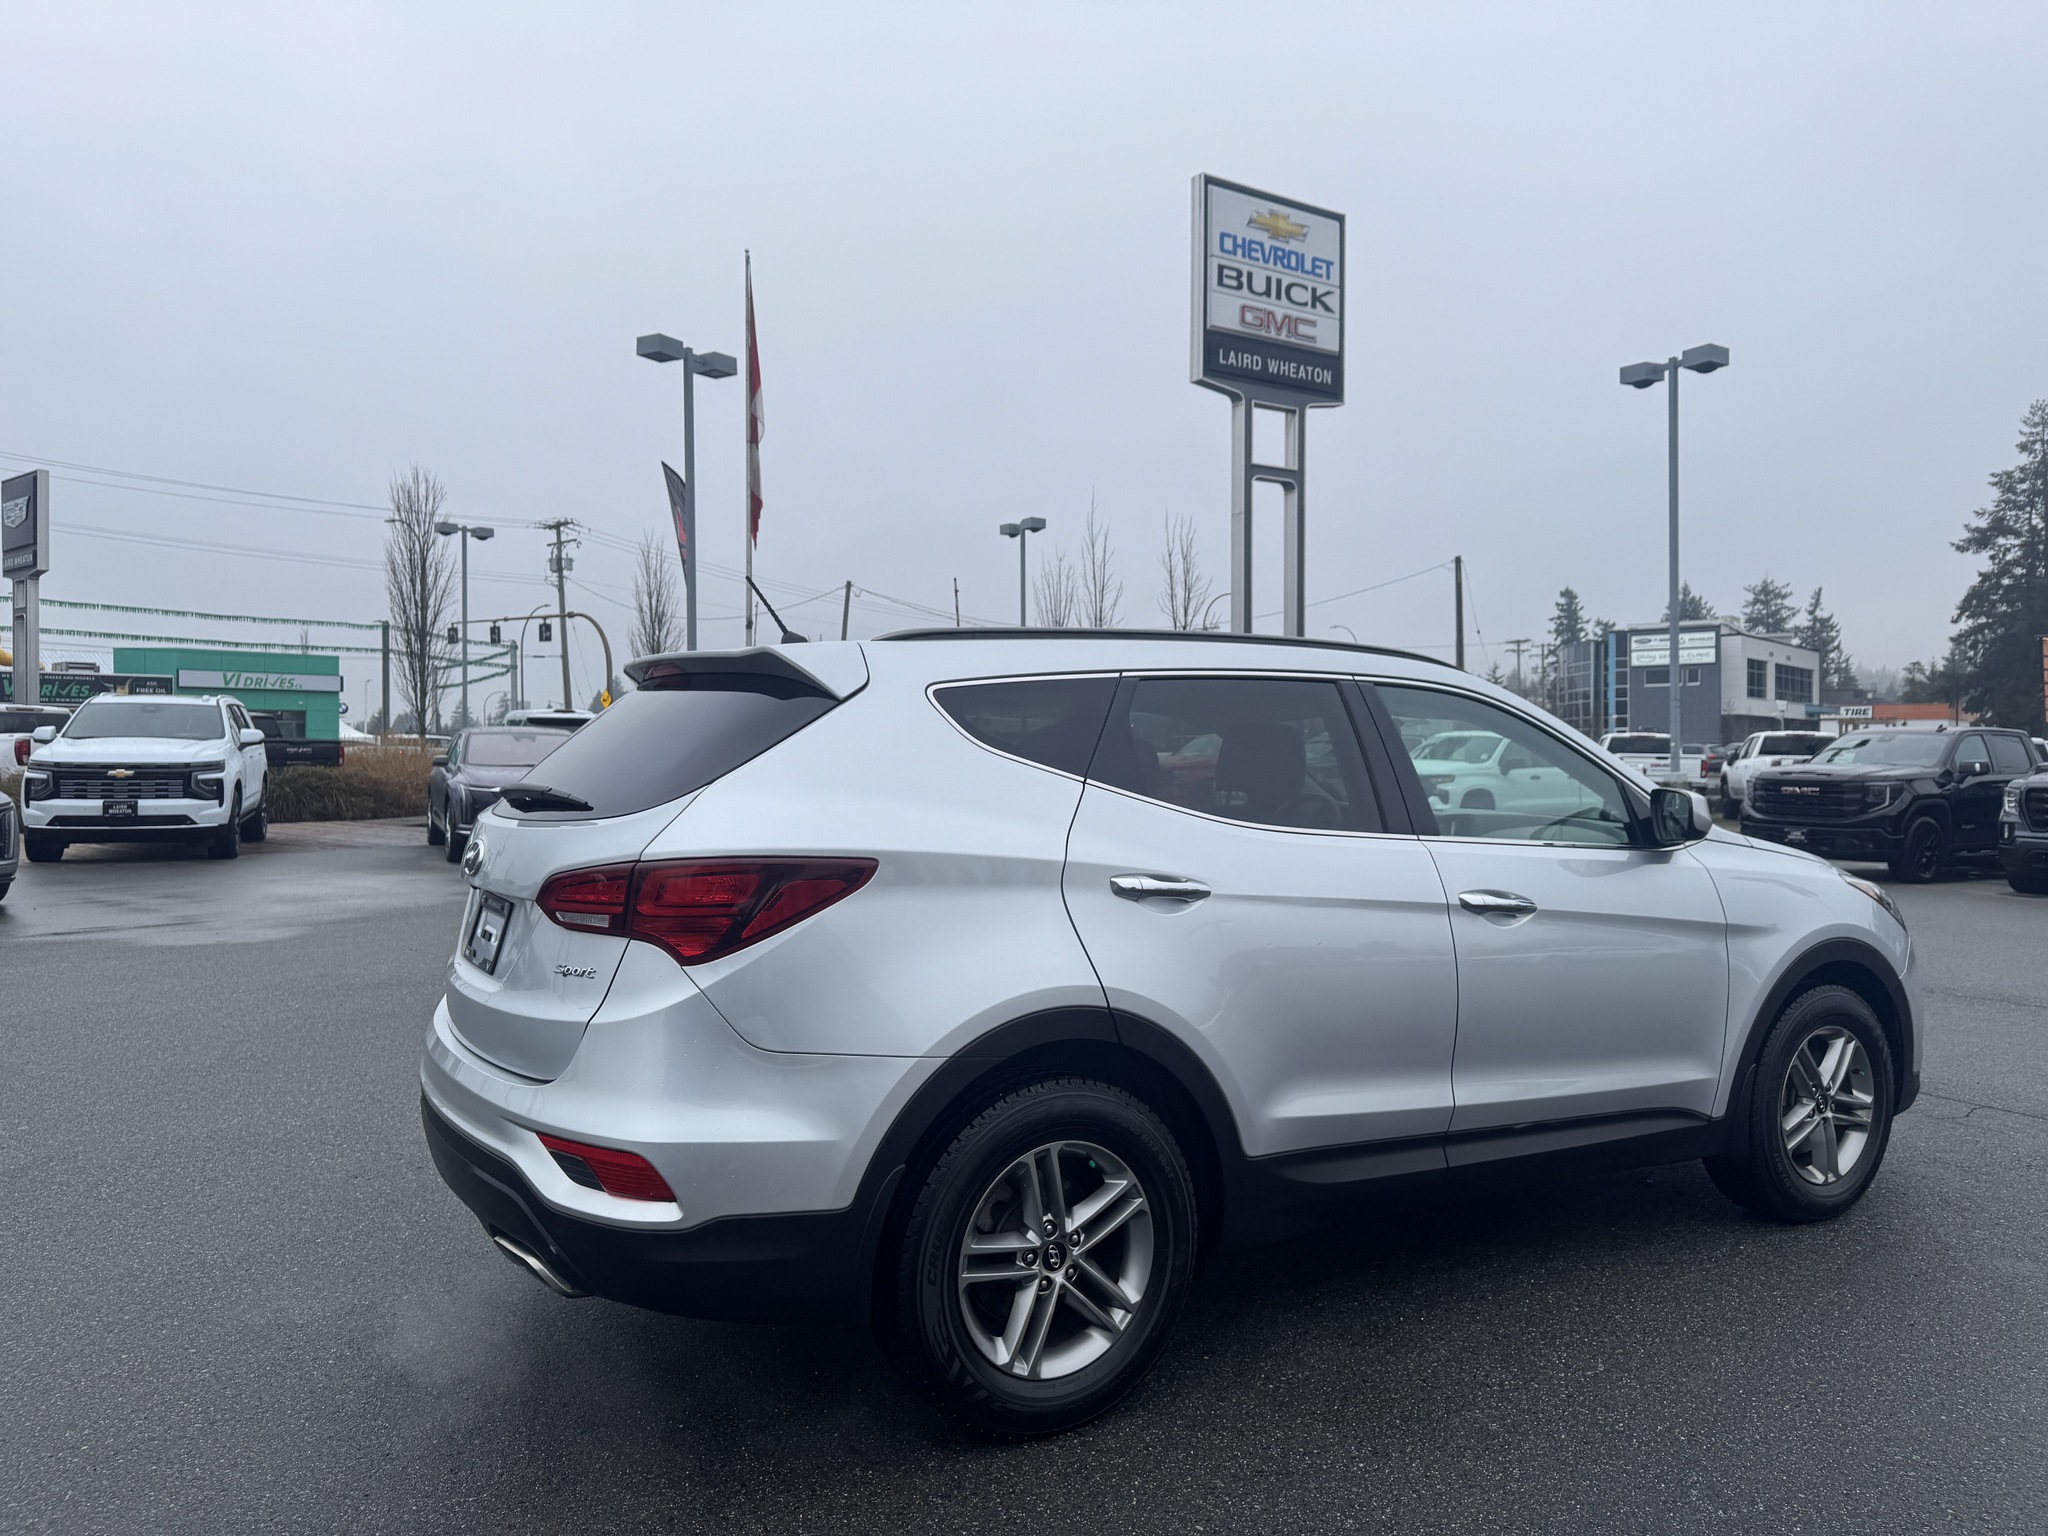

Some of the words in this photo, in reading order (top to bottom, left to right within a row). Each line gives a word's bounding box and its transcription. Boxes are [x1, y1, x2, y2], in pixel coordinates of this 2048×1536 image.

[1219, 231, 1334, 280] CHEVROLET
[1217, 264, 1335, 314] BUICK
[1239, 304, 1317, 343] GMC
[1219, 349, 1262, 371] LAIRD
[1267, 357, 1332, 385] WHEATON
[222, 673, 241, 687] VI
[1844, 708, 1870, 716] TIRE
[553, 964, 596, 979] Sport
